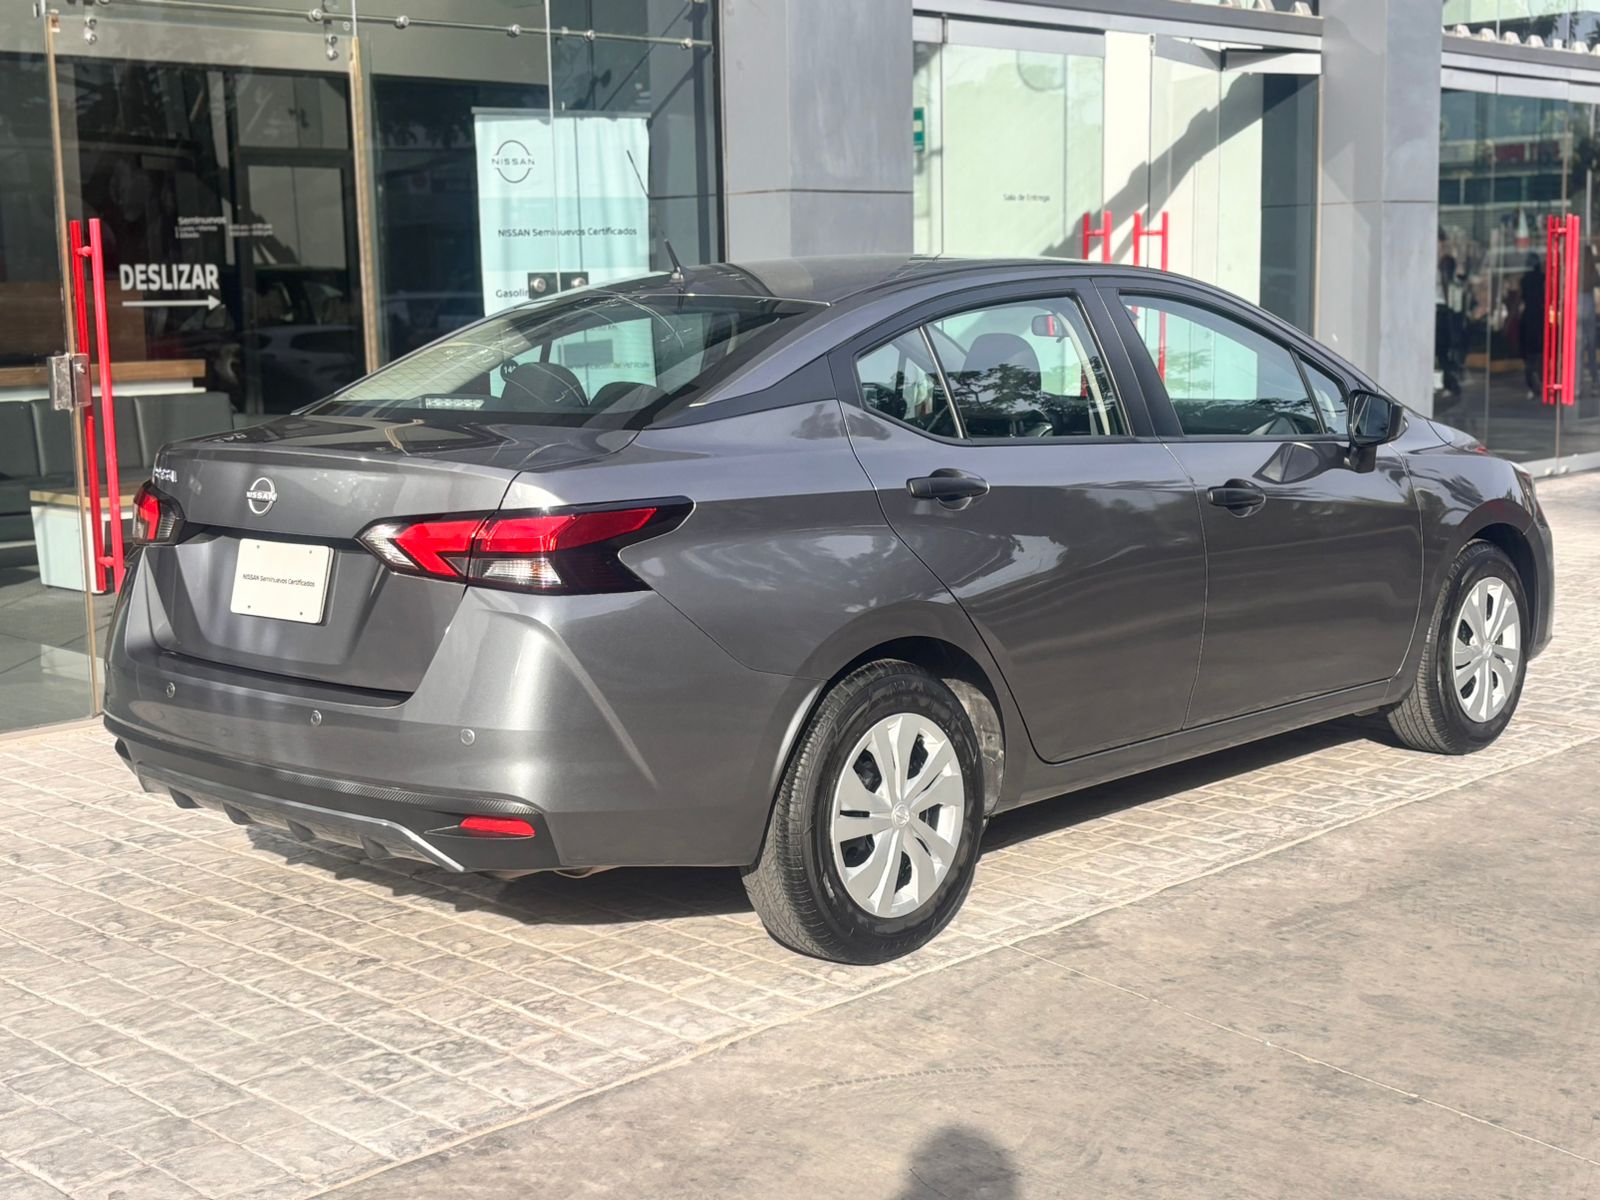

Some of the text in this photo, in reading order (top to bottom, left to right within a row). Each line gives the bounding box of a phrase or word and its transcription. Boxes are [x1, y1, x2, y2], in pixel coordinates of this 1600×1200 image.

[491, 157, 536, 166] NISSAN
[497, 226, 638, 238] NISSAN Seminuevos Certificados
[118, 263, 220, 291] DESLIZAR
[495, 288, 529, 299] Gasolin
[246, 490, 278, 502] NISSAN
[242, 573, 316, 587] NISSAN Seminuevos Certificados
